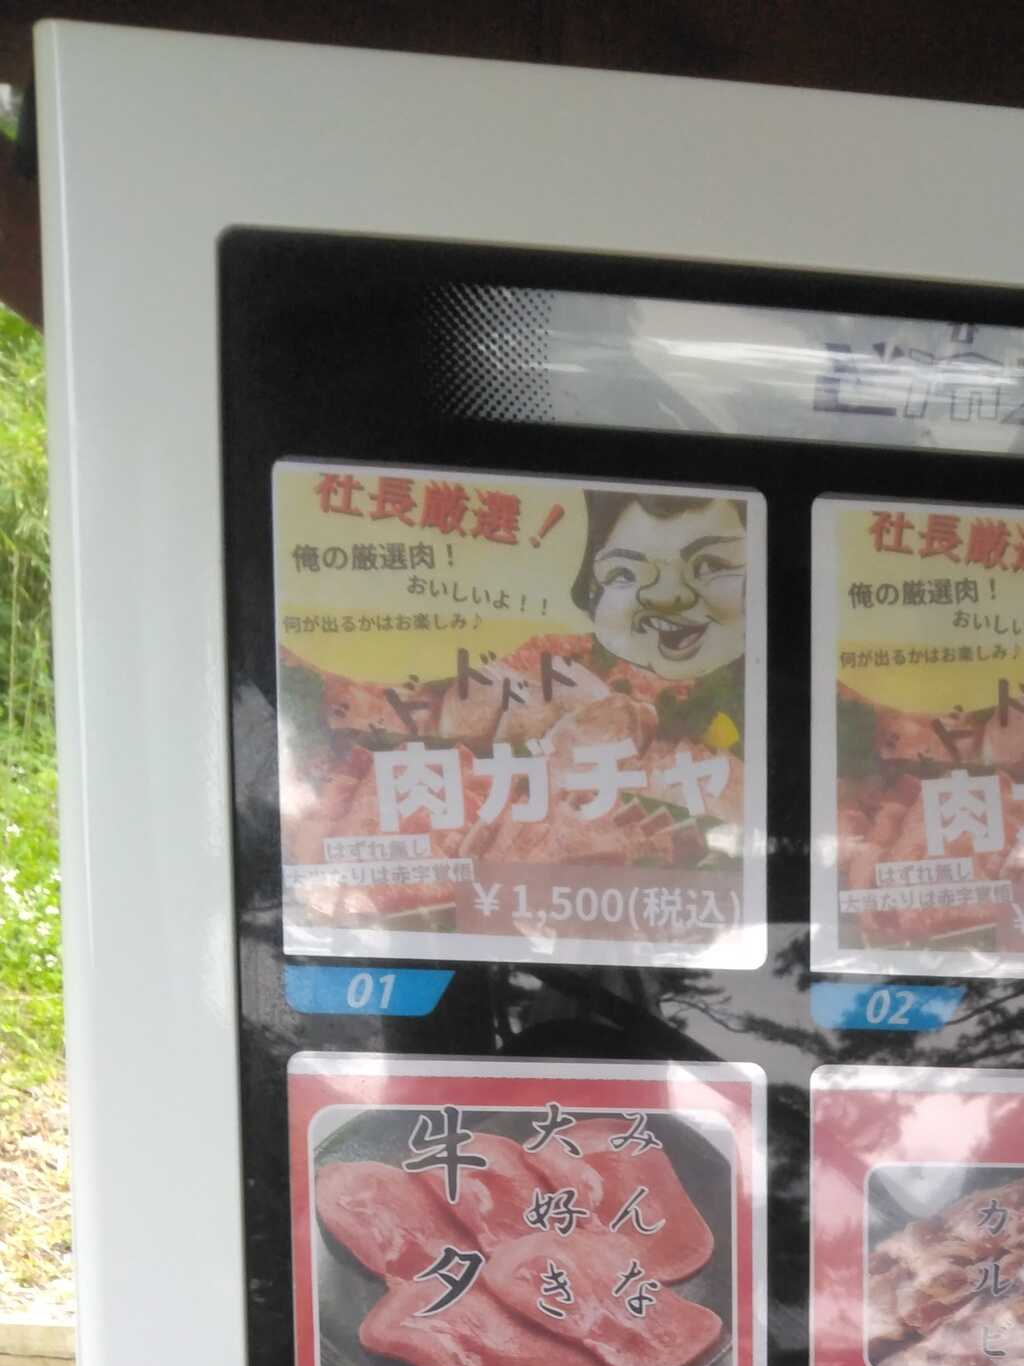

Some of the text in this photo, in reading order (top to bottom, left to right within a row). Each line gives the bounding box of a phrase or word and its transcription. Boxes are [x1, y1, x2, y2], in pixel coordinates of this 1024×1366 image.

[374, 739, 731, 833] 肉ガチャ
[347, 973, 395, 1008] 01
[865, 991, 916, 1025] 02
[523, 1102, 589, 1319] 大好き
[609, 1111, 665, 1317] みんな
[974, 1199, 1017, 1359] カルビ
